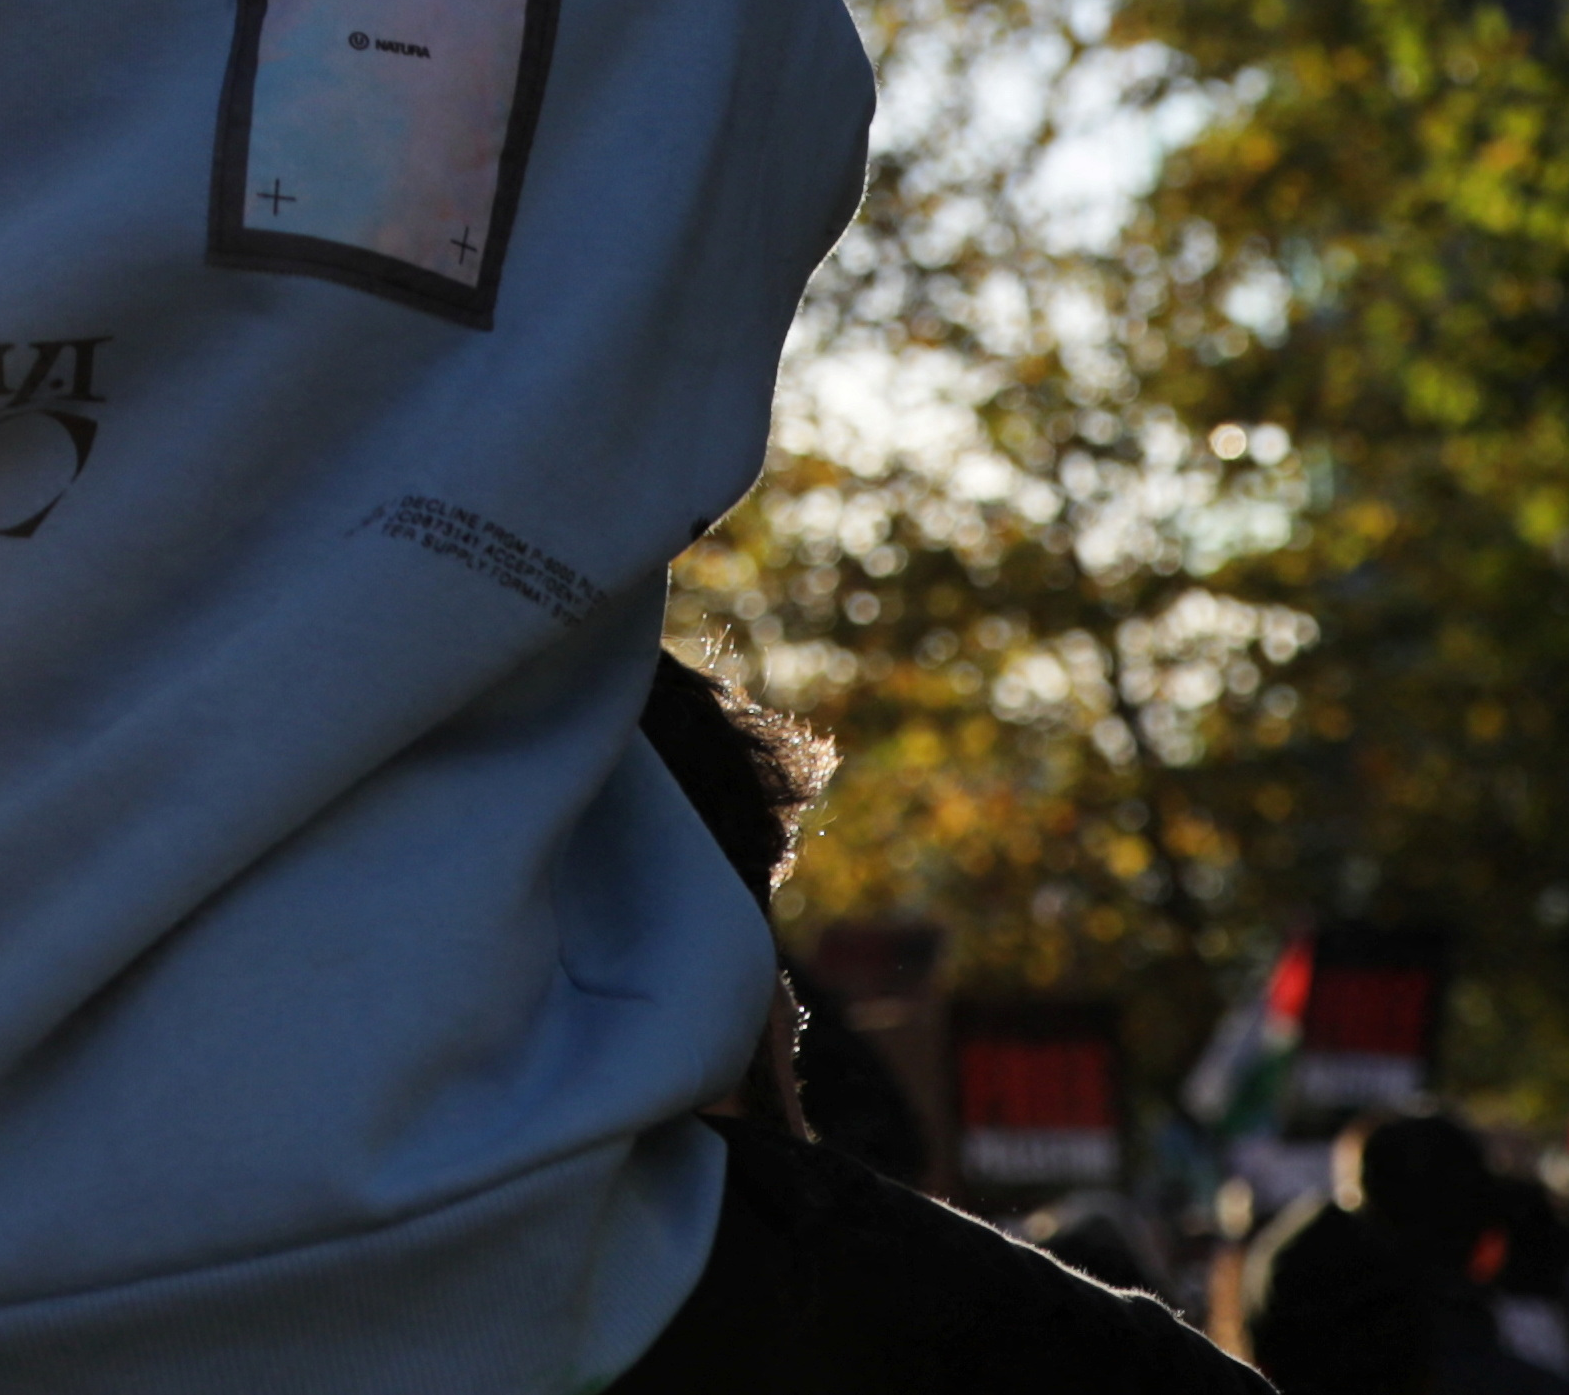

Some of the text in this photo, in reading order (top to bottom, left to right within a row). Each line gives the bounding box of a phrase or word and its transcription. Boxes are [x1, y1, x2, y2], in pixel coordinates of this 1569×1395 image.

[375, 39, 431, 59] NATURA
[401, 495, 481, 529] DECLINE
[422, 533, 488, 572] SUPPLY
[490, 565, 551, 610] FORMAT
